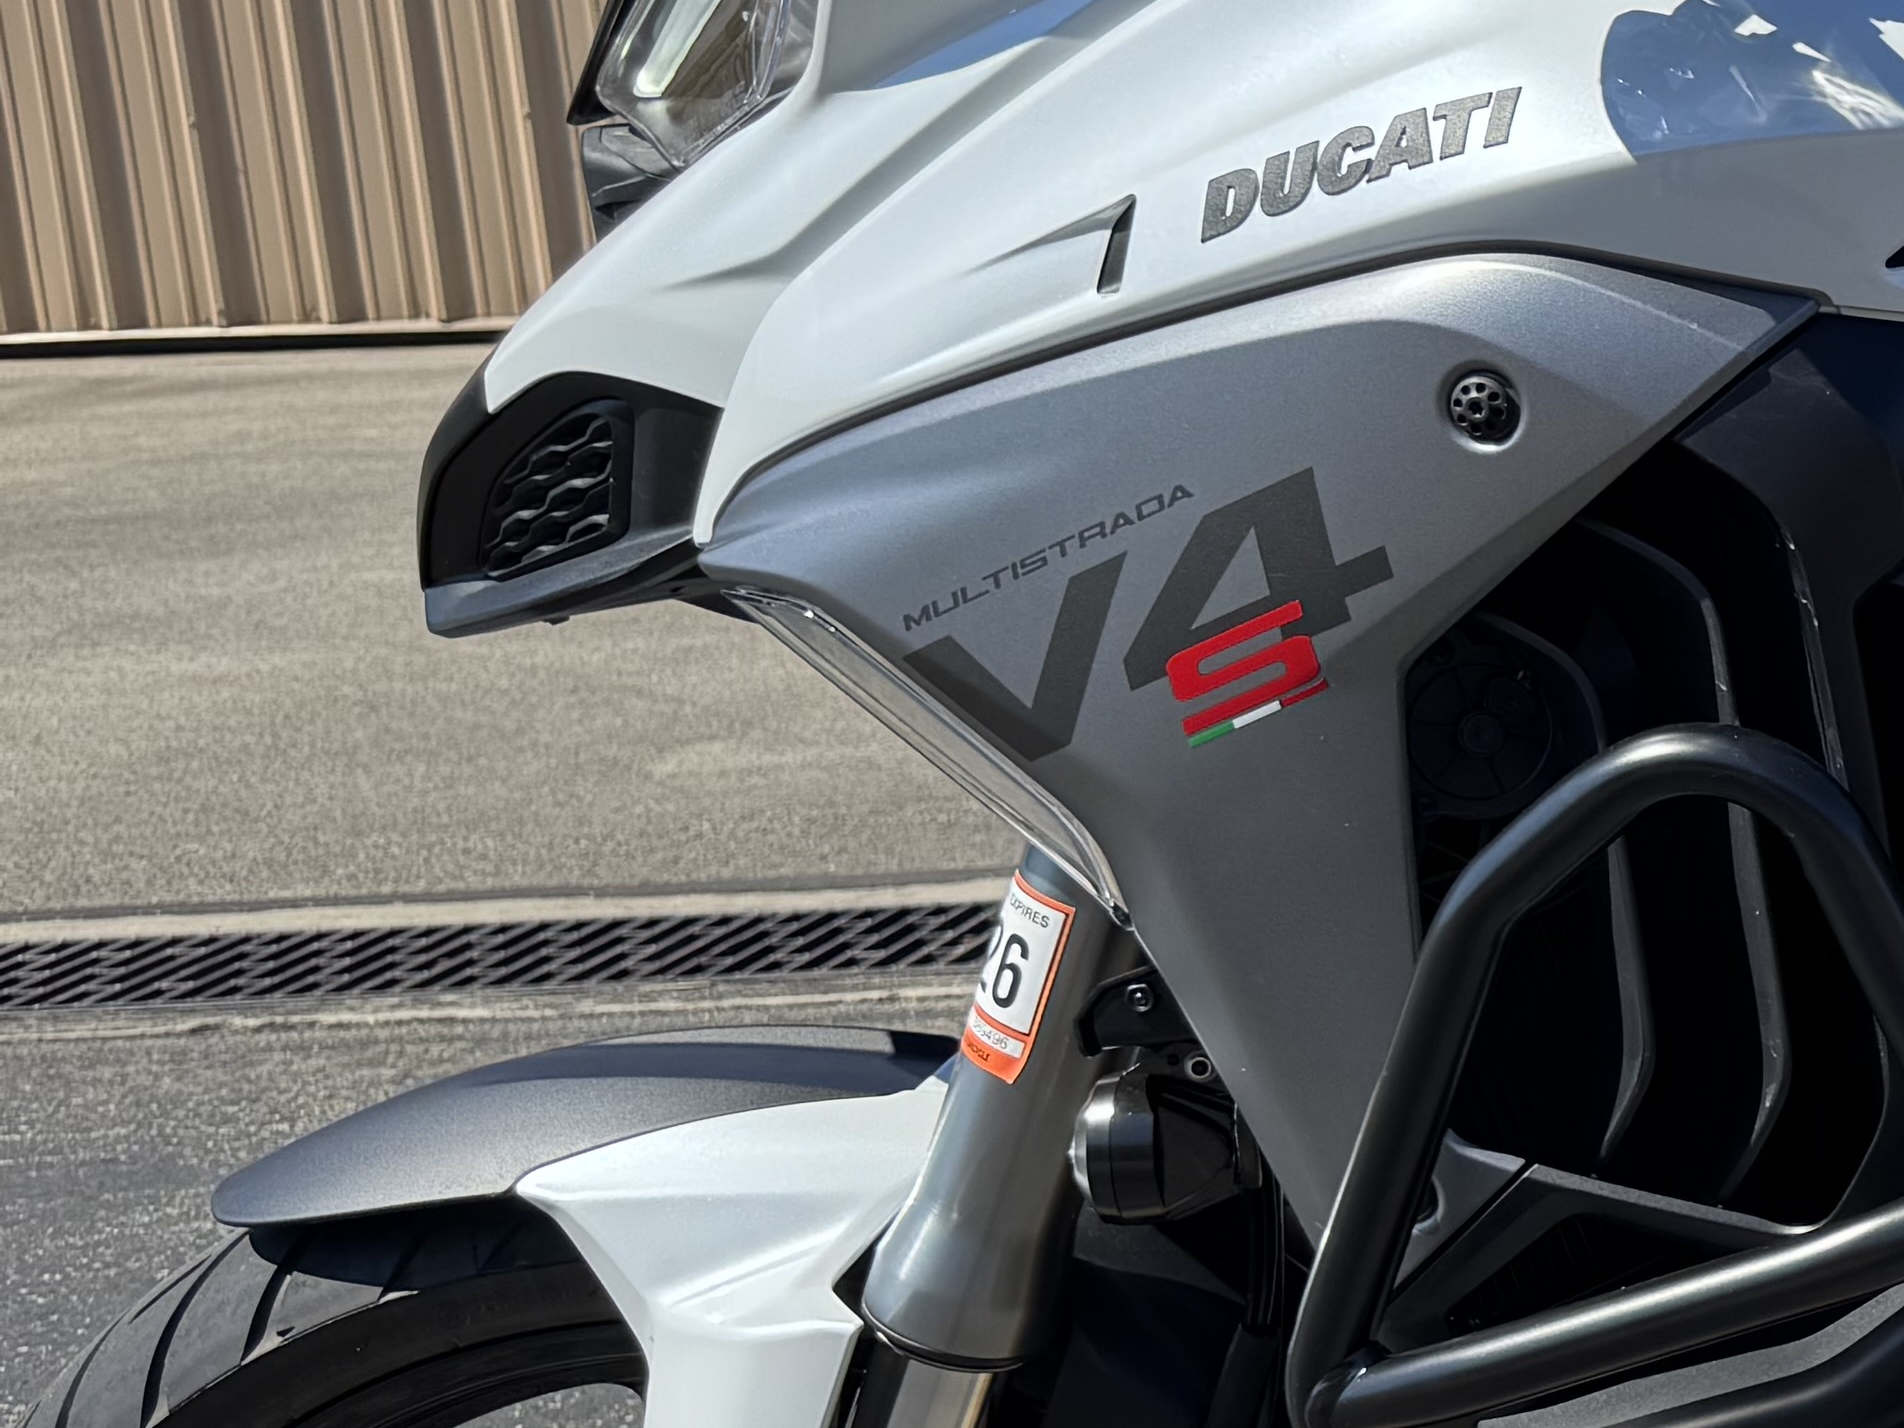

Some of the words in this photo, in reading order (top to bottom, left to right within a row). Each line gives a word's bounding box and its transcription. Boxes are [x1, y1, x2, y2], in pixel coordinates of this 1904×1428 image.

[1200, 86, 1522, 243] DUCATI
[903, 483, 1194, 633] MULTISTRADA
[903, 466, 1395, 762] V4
